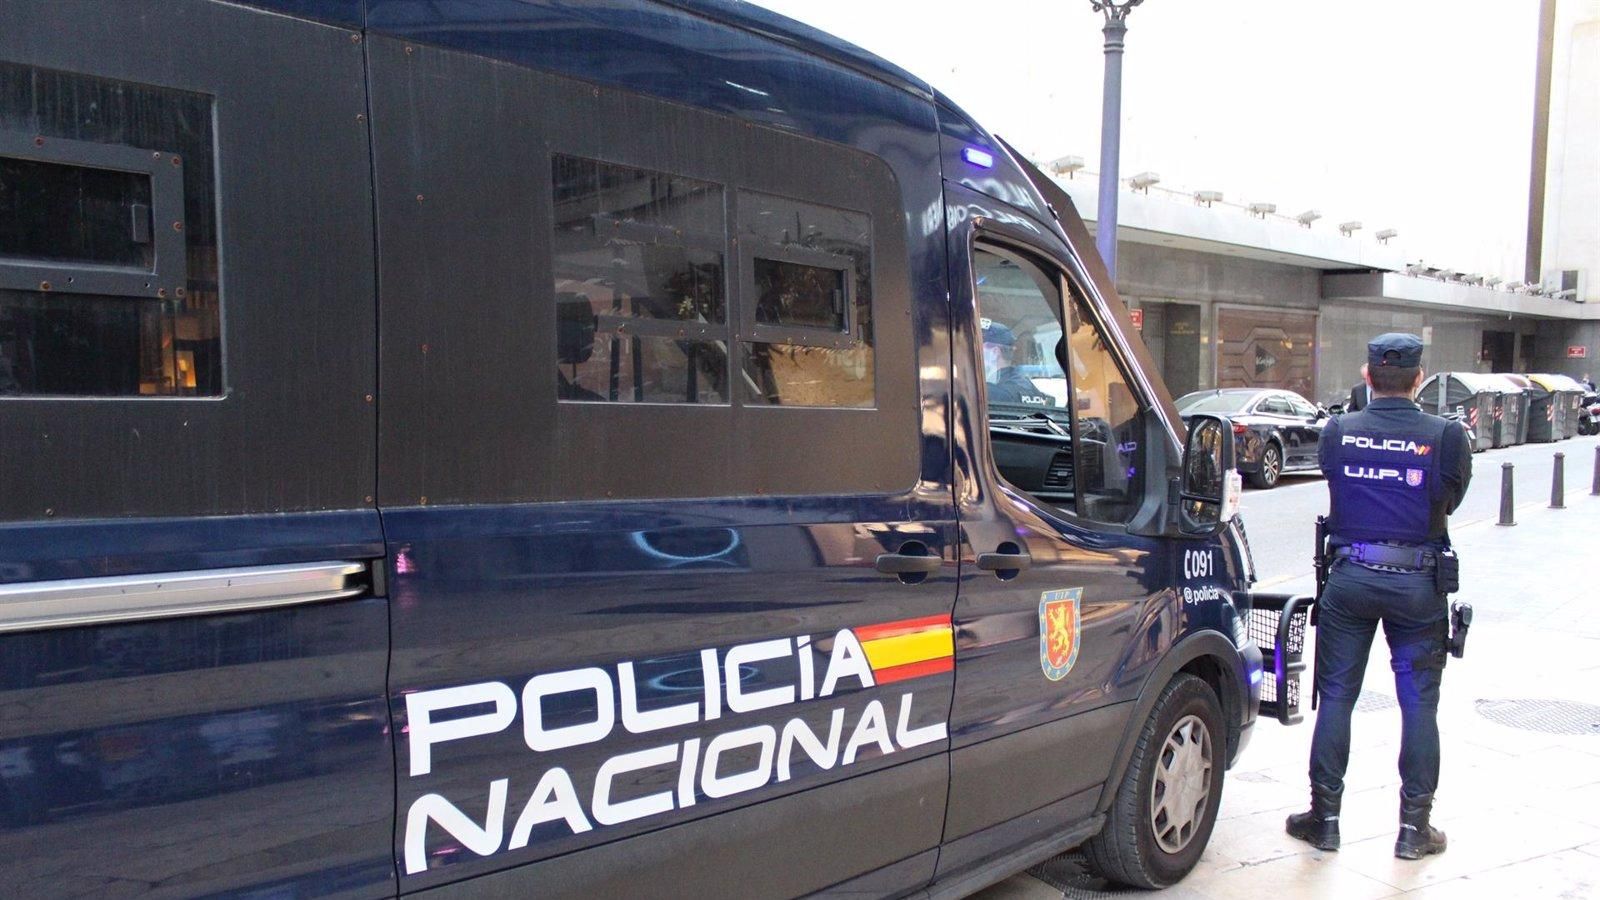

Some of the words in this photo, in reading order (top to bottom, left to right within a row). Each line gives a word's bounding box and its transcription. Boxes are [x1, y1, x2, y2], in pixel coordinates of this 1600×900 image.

[1341, 435, 1419, 455] POLICIA
[1344, 465, 1404, 481] U.I.P.
[1191, 549, 1213, 578] 091
[405, 693, 948, 874] NACIONAL
